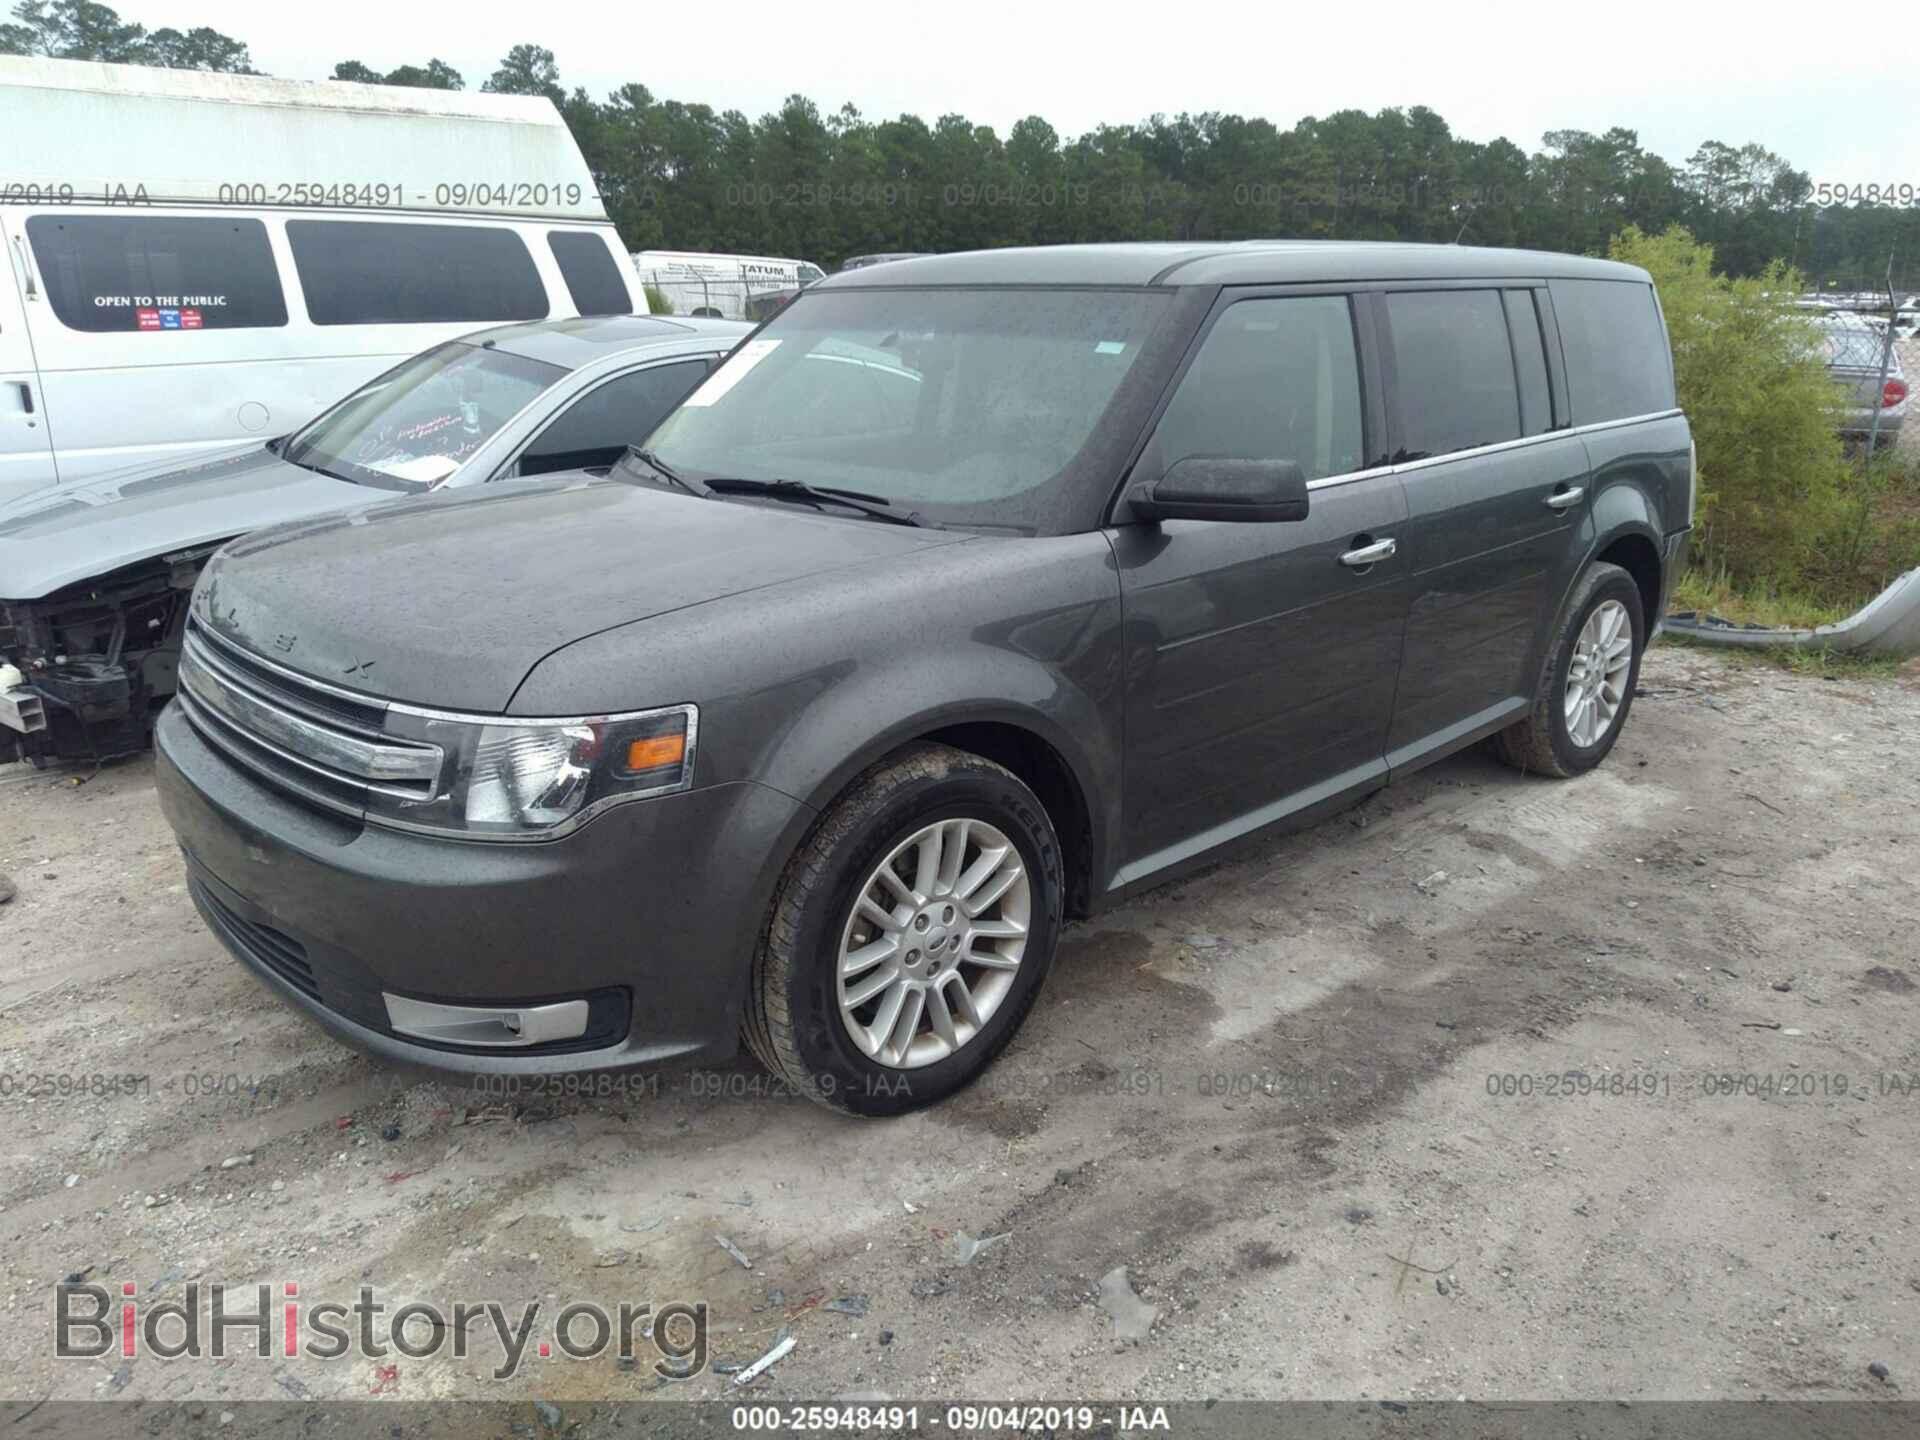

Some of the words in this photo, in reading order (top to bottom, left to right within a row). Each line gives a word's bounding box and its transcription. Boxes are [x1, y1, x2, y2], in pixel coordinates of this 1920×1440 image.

[740, 264, 784, 275] TATUM
[94, 296, 131, 307] OPEN
[133, 296, 153, 307] TO
[155, 296, 180, 306] THE
[182, 295, 227, 306] PUBLIC
